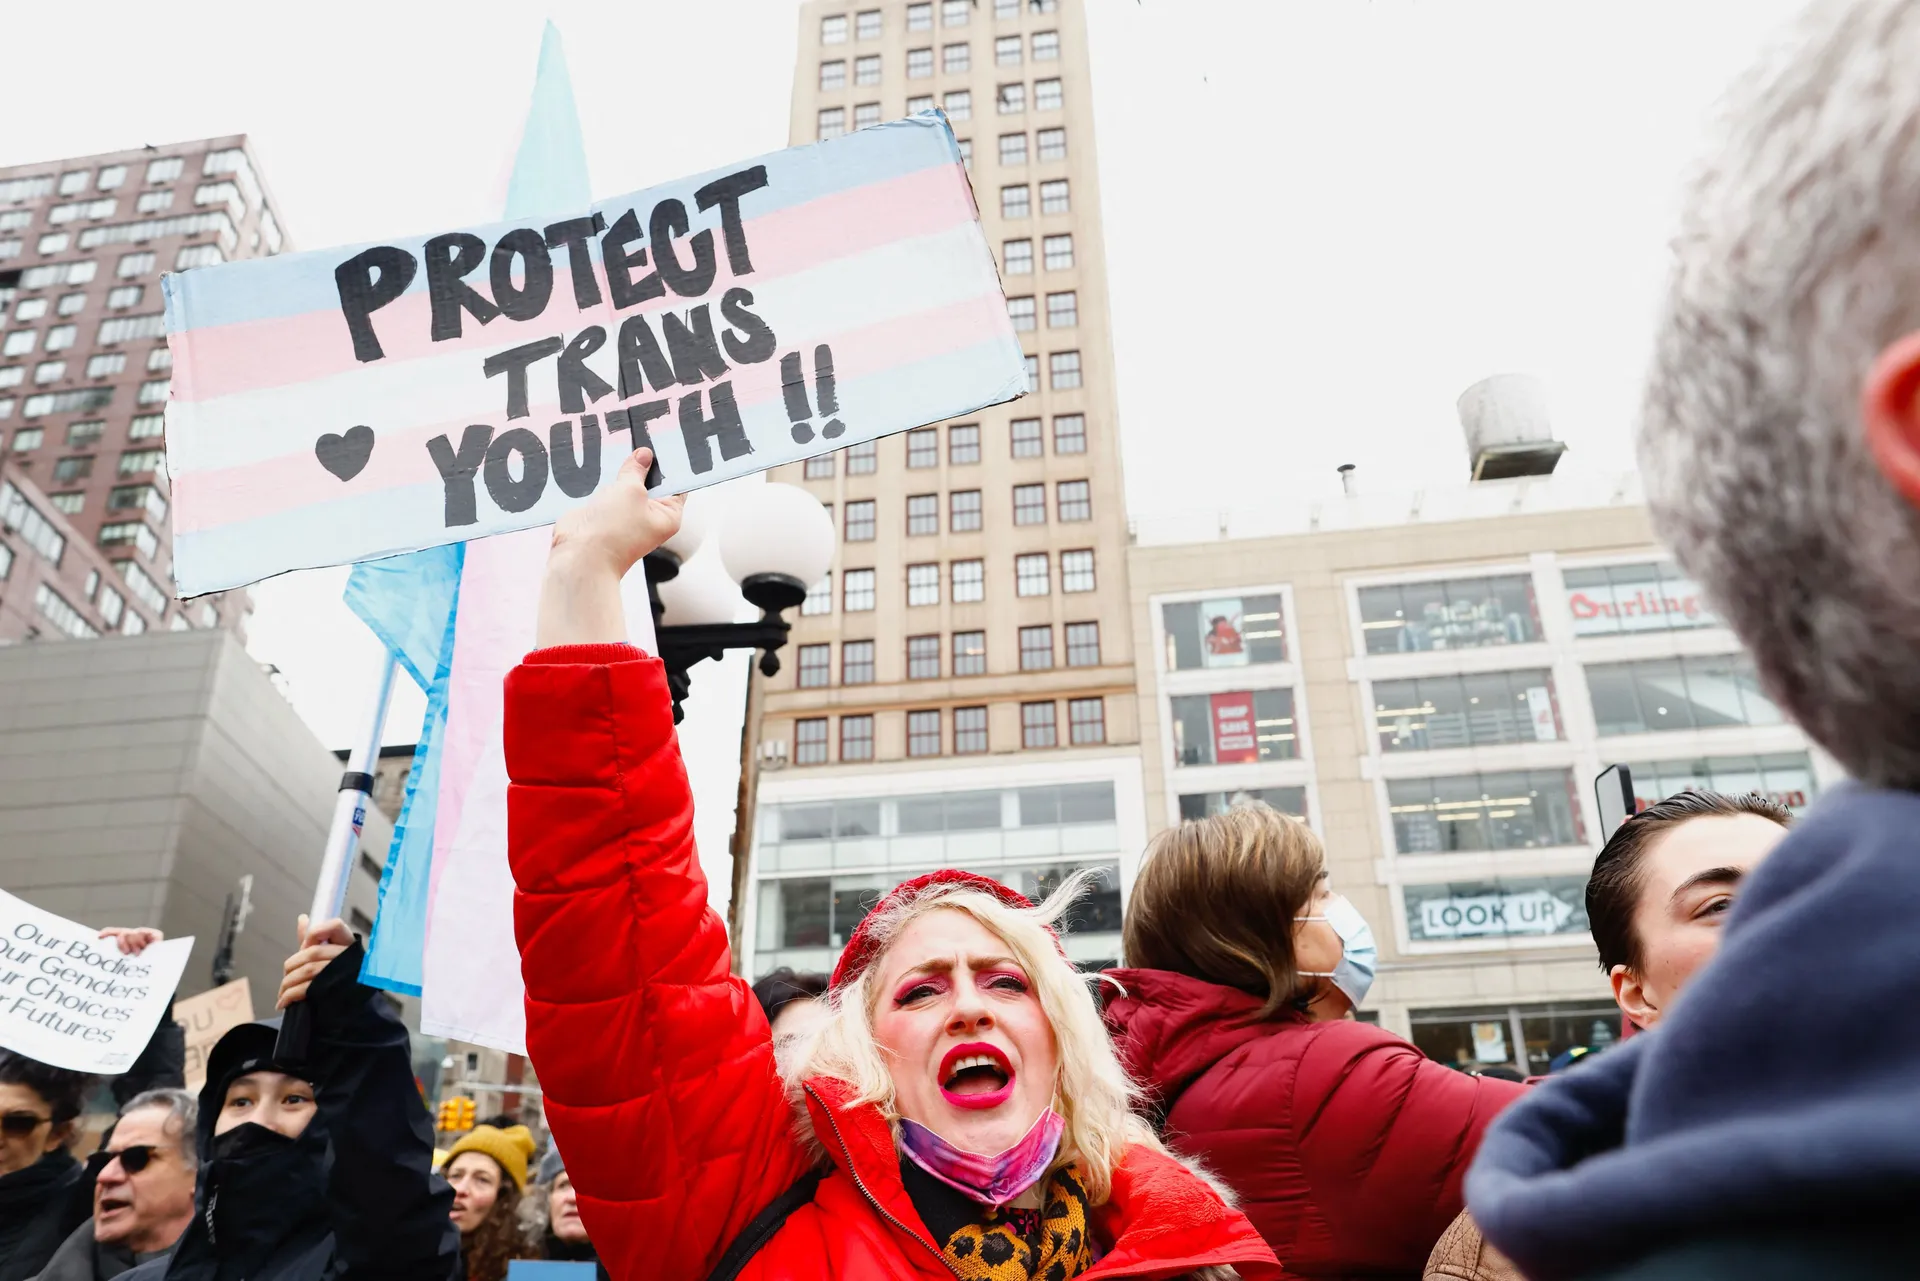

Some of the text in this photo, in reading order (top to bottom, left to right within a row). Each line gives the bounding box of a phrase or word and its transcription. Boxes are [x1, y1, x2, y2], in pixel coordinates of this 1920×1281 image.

[334, 165, 768, 363] PROTECT
[483, 288, 777, 420] TRANS
[426, 344, 846, 528] YOUTH !!
[1429, 901, 1556, 928] LOOK UP
[14, 923, 152, 979] Our Bodies
[25, 976, 135, 1022] Choices
[39, 955, 150, 1001] Genders
[8, 997, 116, 1044] Futures
